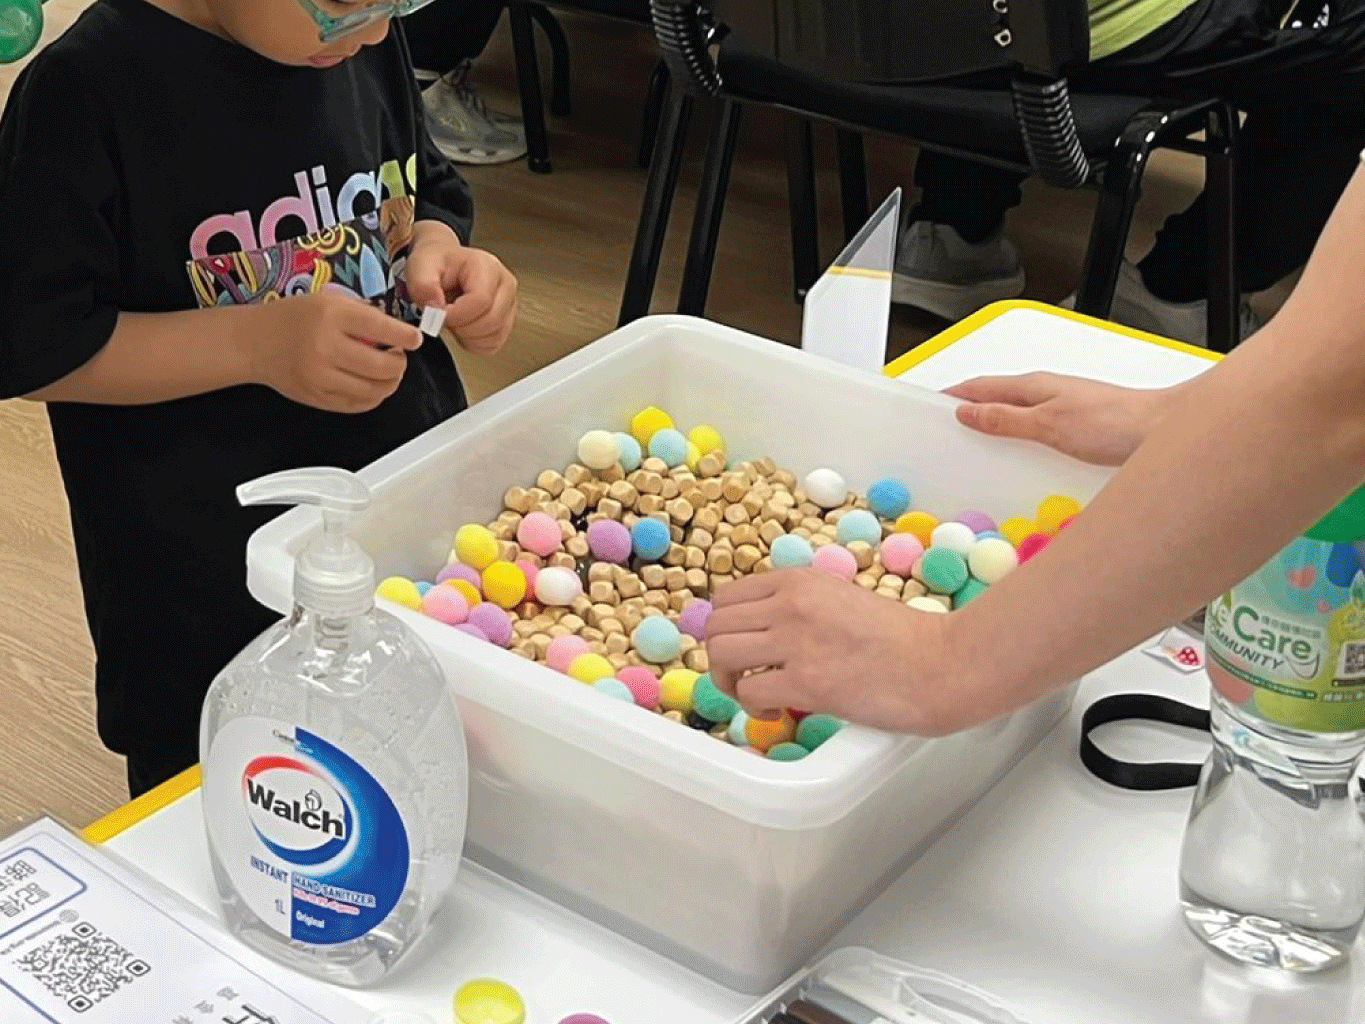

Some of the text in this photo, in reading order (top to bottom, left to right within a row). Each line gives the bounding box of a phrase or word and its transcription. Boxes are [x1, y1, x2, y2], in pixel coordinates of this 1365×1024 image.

[1209, 623, 1285, 670] OMMUNITY
[1234, 606, 1311, 659] Care
[247, 778, 343, 836] Walch
[250, 856, 288, 883] INSTANT
[293, 874, 320, 893] HAND
[321, 884, 376, 908] SANITIZER
